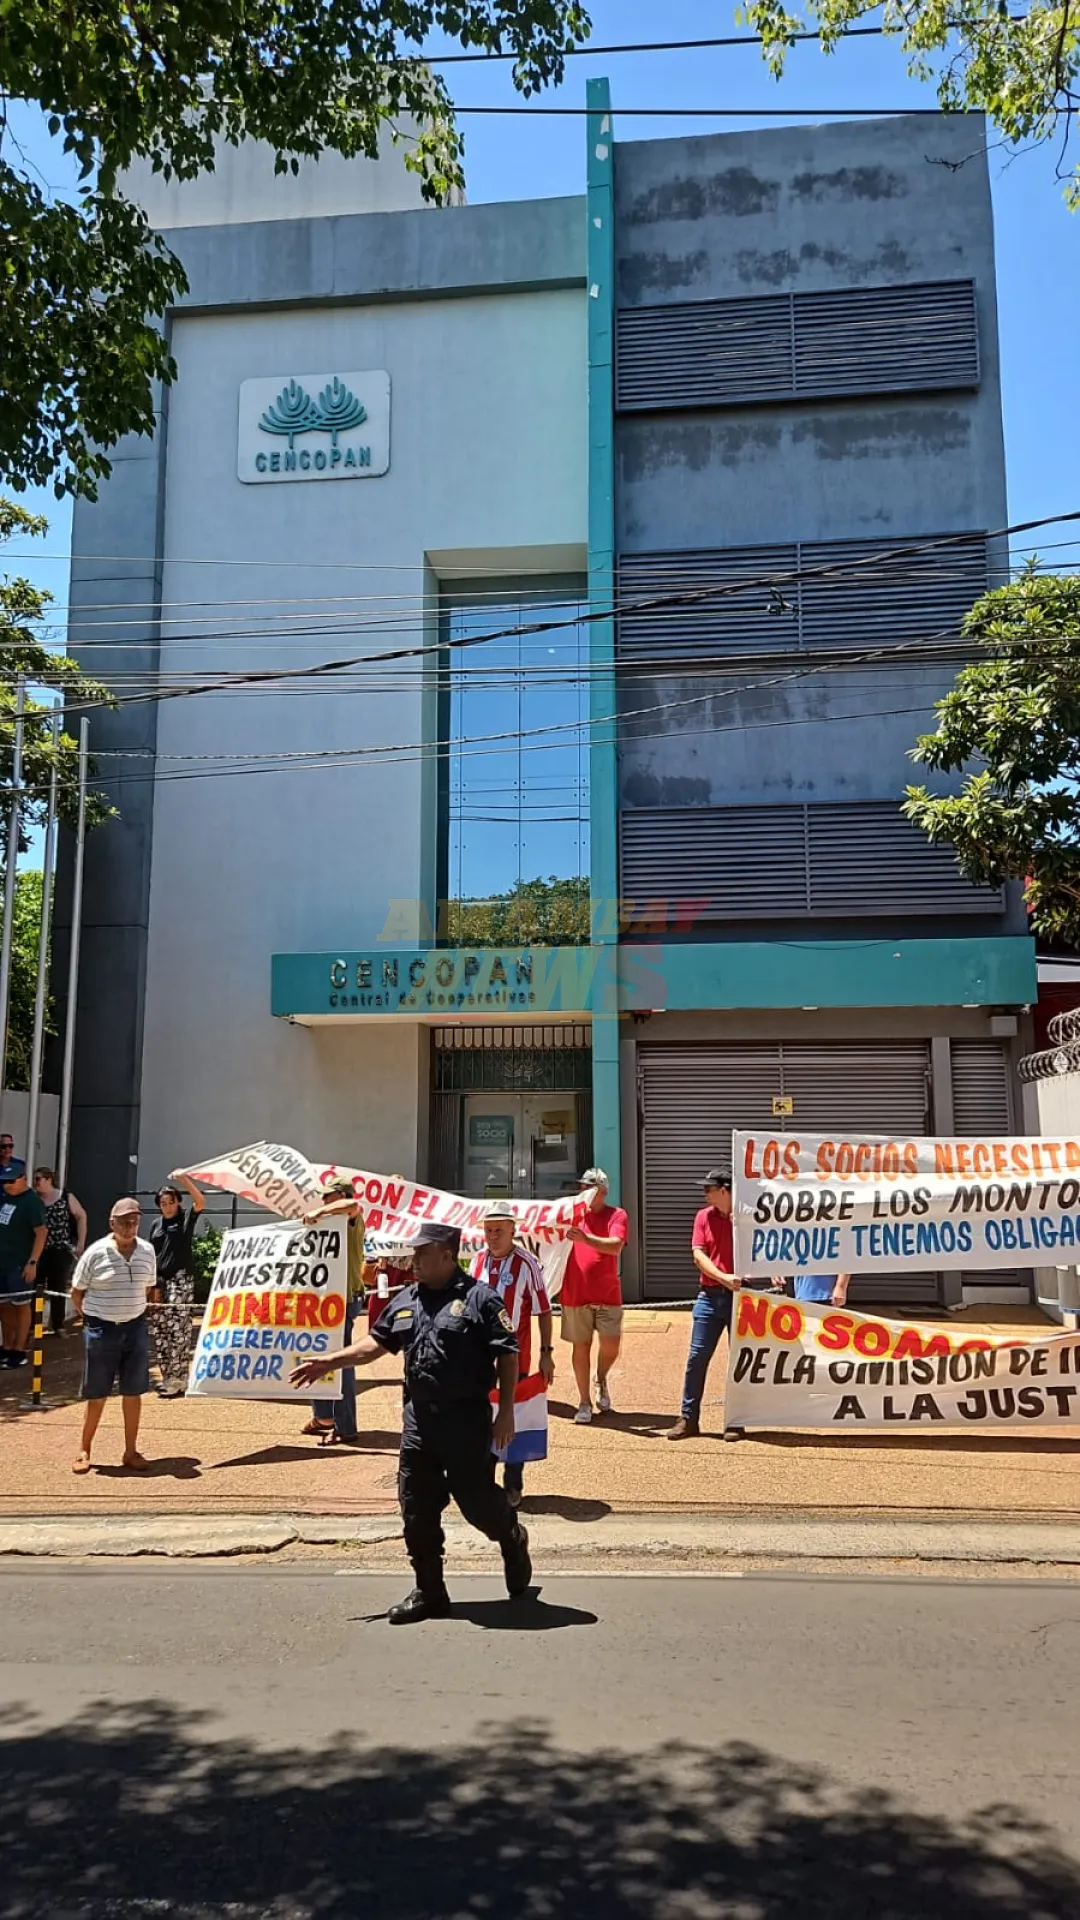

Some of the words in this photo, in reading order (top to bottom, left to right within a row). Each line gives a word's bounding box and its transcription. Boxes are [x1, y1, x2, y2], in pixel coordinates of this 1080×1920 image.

[255, 446, 371, 473] CENCOPAN
[329, 956, 533, 989] CENCOPAN
[329, 991, 390, 1009] Central
[399, 990, 417, 1006] de
[426, 989, 536, 1007] Cooperativas
[744, 1139, 801, 1180] LOS
[814, 1141, 918, 1181] SOCIOS
[351, 1175, 405, 1210] CON
[407, 1188, 440, 1220] EL
[518, 1203, 552, 1233] DE
[753, 1189, 855, 1224] SOBRE
[872, 1187, 932, 1218] LOS
[948, 1178, 1080, 1213] MONTO
[222, 1234, 281, 1263] DONDE
[285, 1230, 341, 1259] ESTA
[751, 1225, 841, 1266] PORQUE
[851, 1220, 972, 1256] TENEMOS
[984, 1215, 1080, 1250] OBLIGA
[214, 1261, 329, 1291] NUESTRO
[208, 1290, 346, 1330] DINERO
[737, 1294, 803, 1341] NO
[202, 1329, 329, 1352] QUEREMOS
[196, 1353, 284, 1381] COBRAR
[733, 1346, 770, 1384] DE
[773, 1350, 816, 1384] LA
[828, 1350, 998, 1386] OMISION
[1009, 1348, 1050, 1376] DE
[832, 1394, 866, 1420] A
[883, 1393, 944, 1421] LA
[956, 1386, 1077, 1420] JUST
